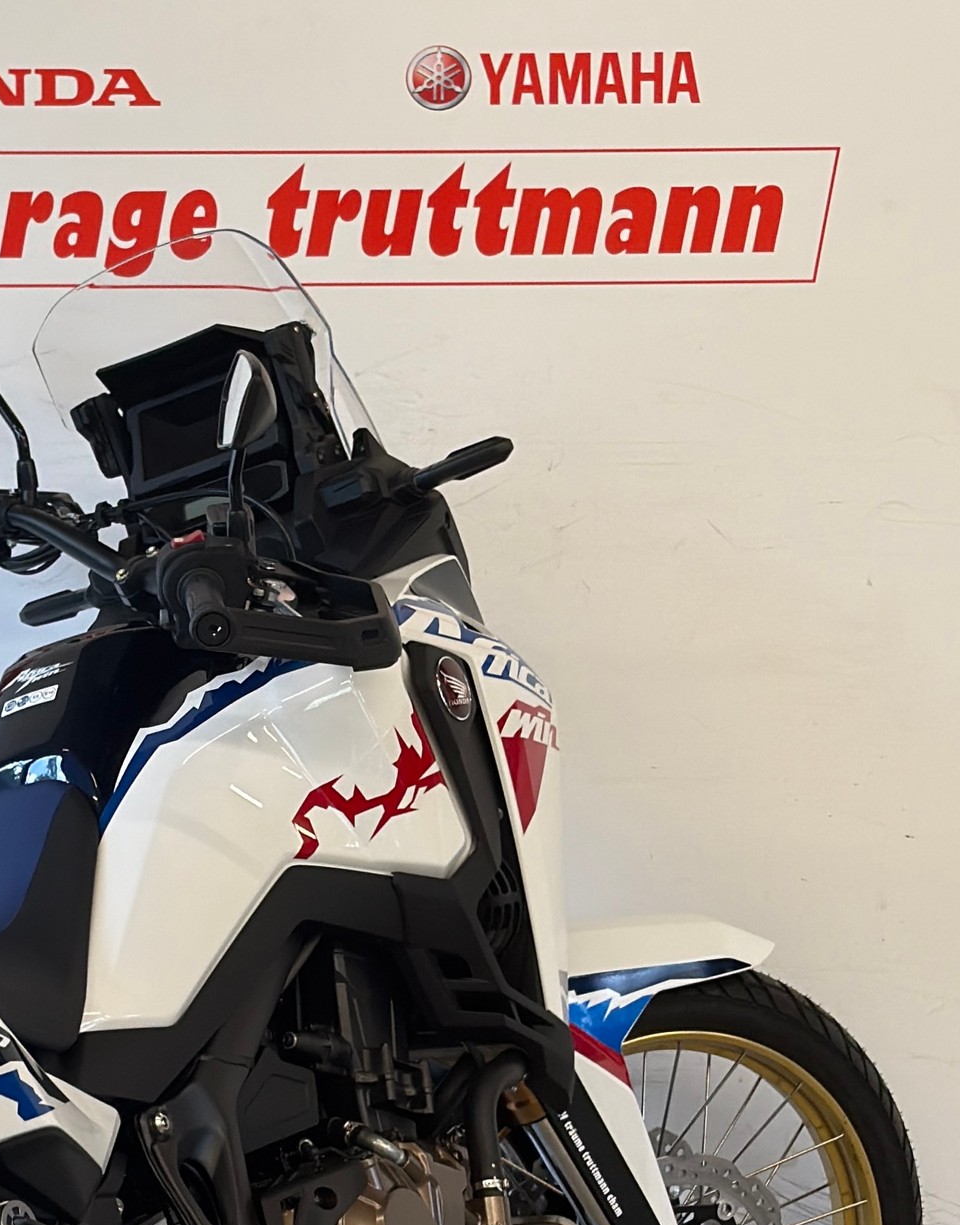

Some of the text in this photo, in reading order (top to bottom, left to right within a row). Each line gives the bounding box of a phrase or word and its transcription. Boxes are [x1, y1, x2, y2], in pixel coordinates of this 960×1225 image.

[480, 51, 701, 105] YAMAHA
[266, 162, 785, 259] truttmann
[581, 1151, 611, 1195] truttmann
[606, 1190, 623, 1218] cham
